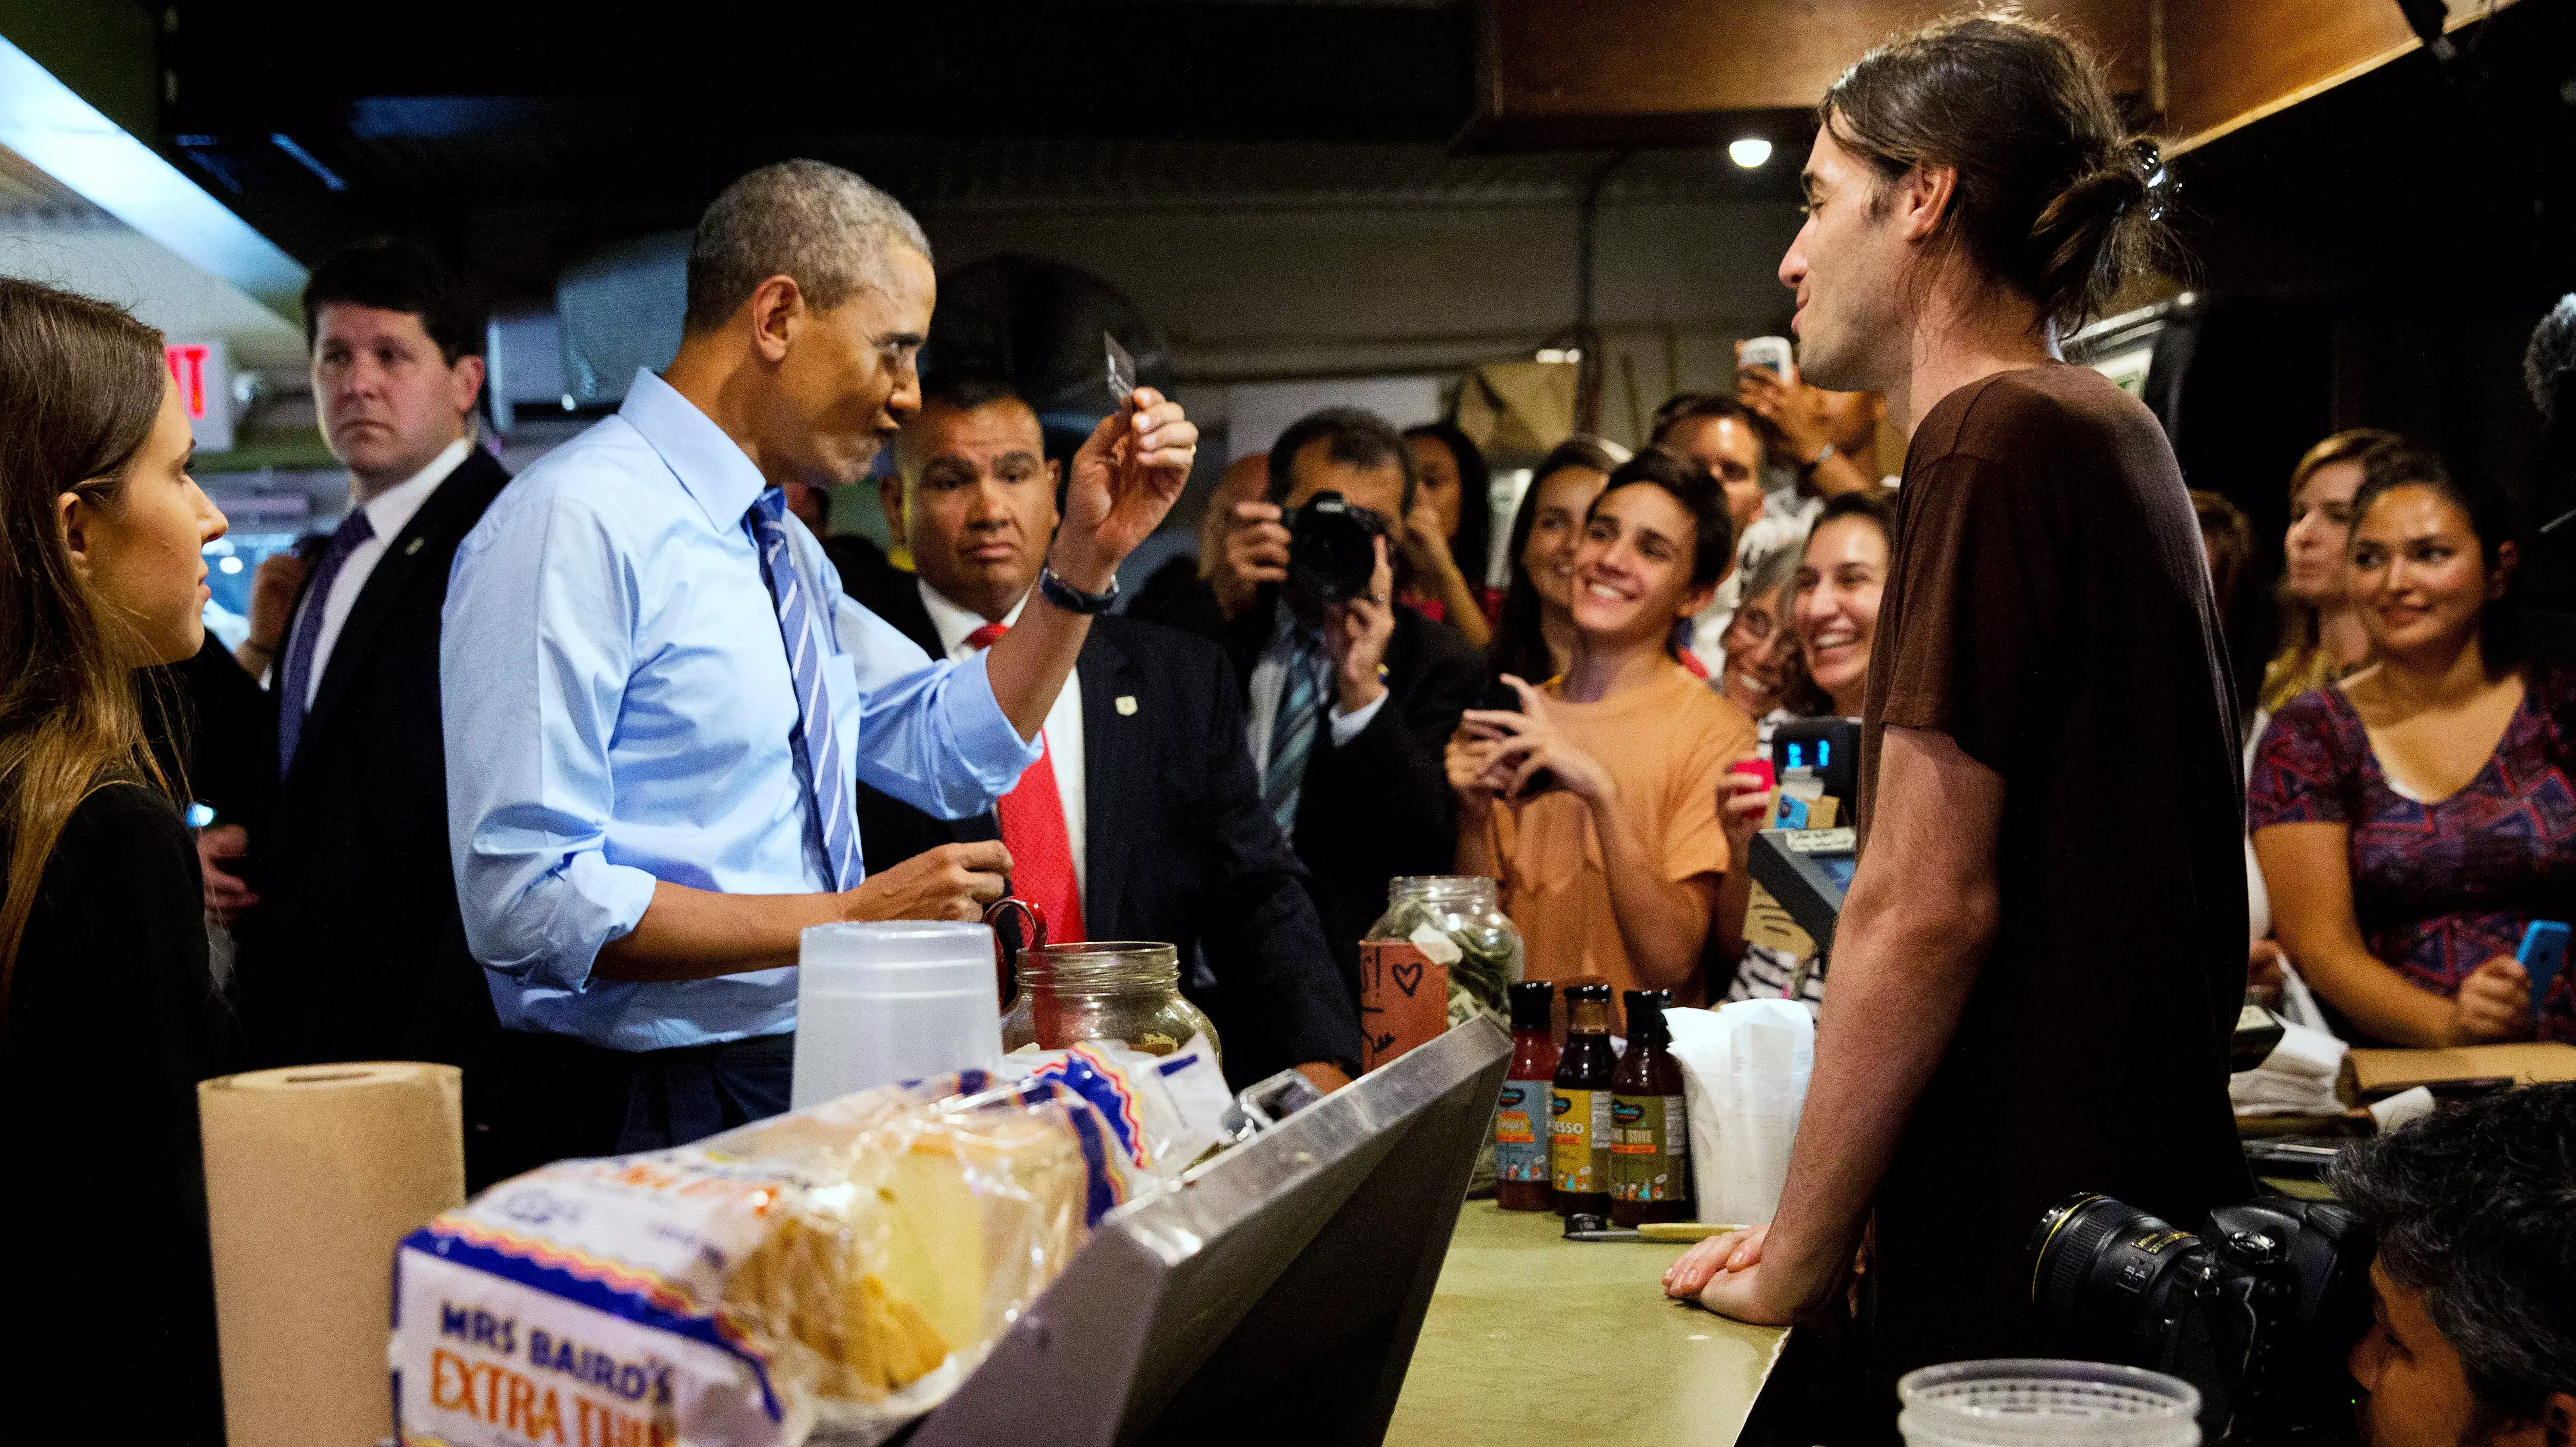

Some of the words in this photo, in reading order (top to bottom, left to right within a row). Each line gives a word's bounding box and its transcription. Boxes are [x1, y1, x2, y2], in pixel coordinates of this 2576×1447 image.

[430, 1348, 568, 1446] EXTRA
[441, 1299, 516, 1355] MRS
[530, 1328, 674, 1406] BAIRD'S
